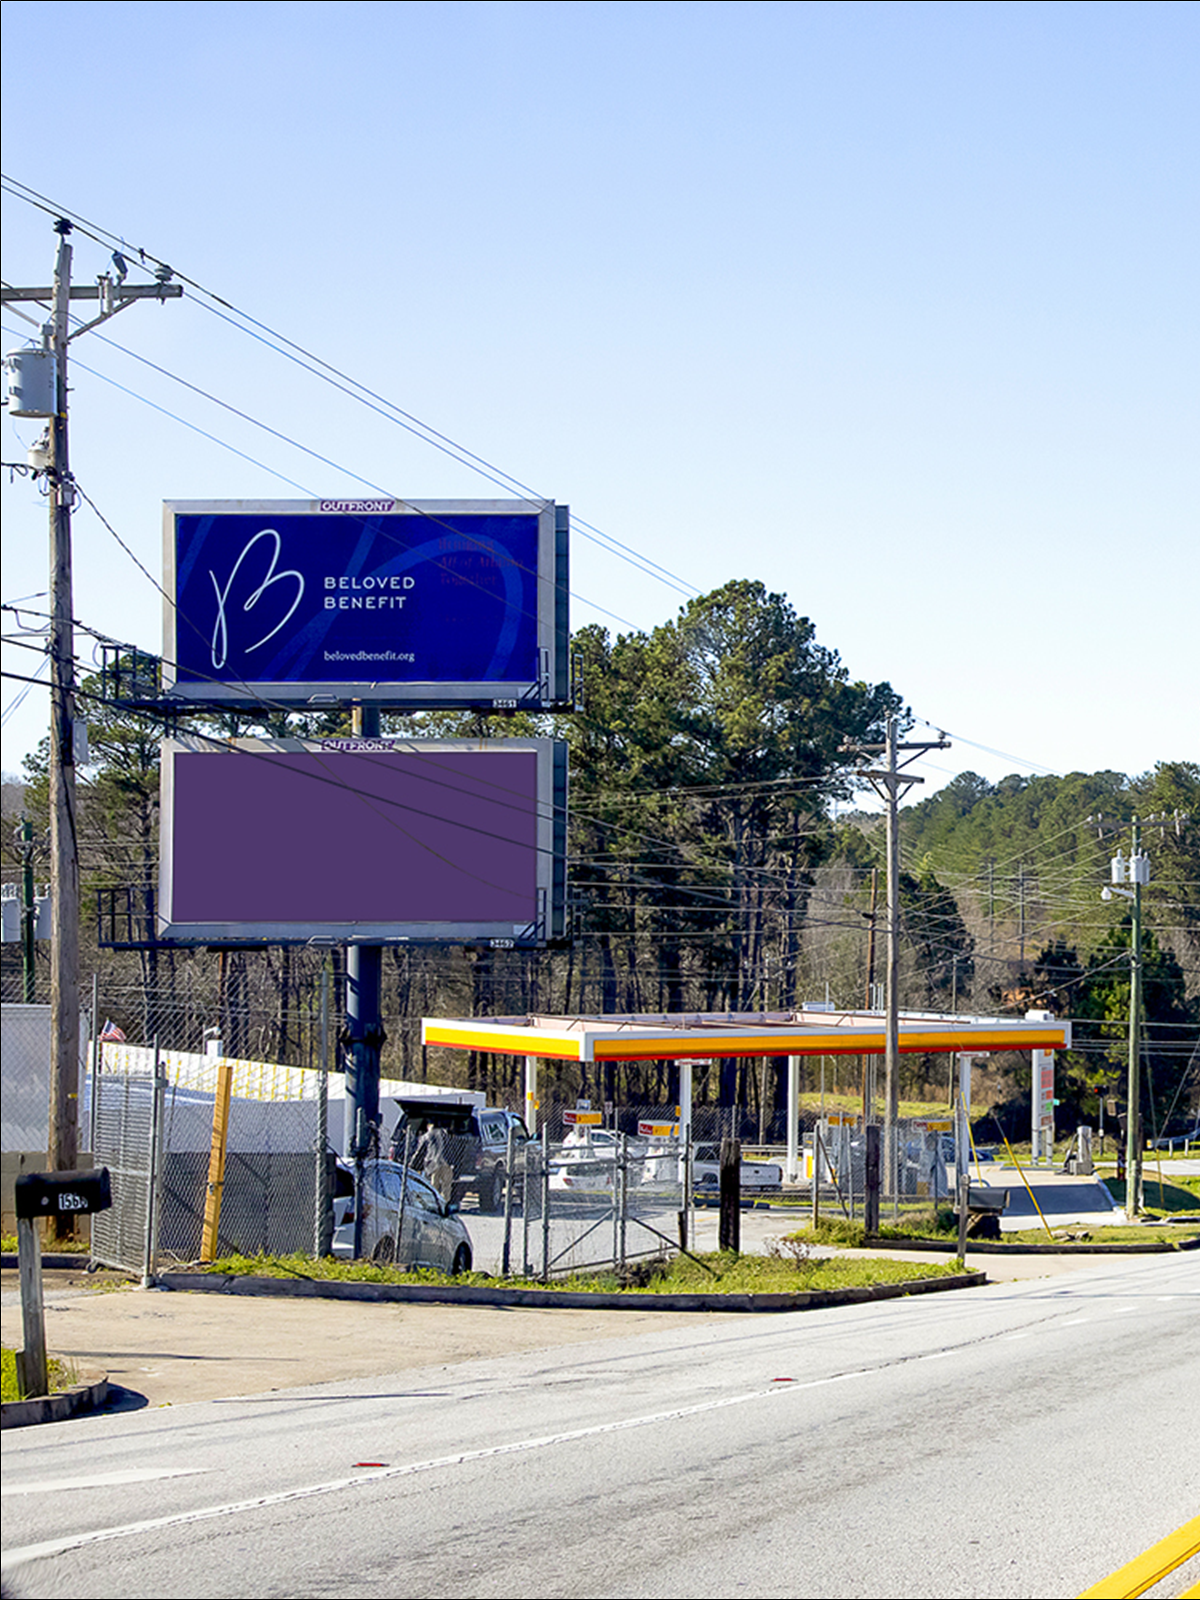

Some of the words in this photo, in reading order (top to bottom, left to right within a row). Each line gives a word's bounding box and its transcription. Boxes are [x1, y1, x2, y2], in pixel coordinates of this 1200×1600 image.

[322, 501, 391, 511] OUTFRONT
[324, 576, 415, 589] BELOVED
[324, 596, 407, 609] BENEFIT
[323, 650, 415, 663] belovedbenefit.org
[322, 740, 391, 751] OUTFRONT
